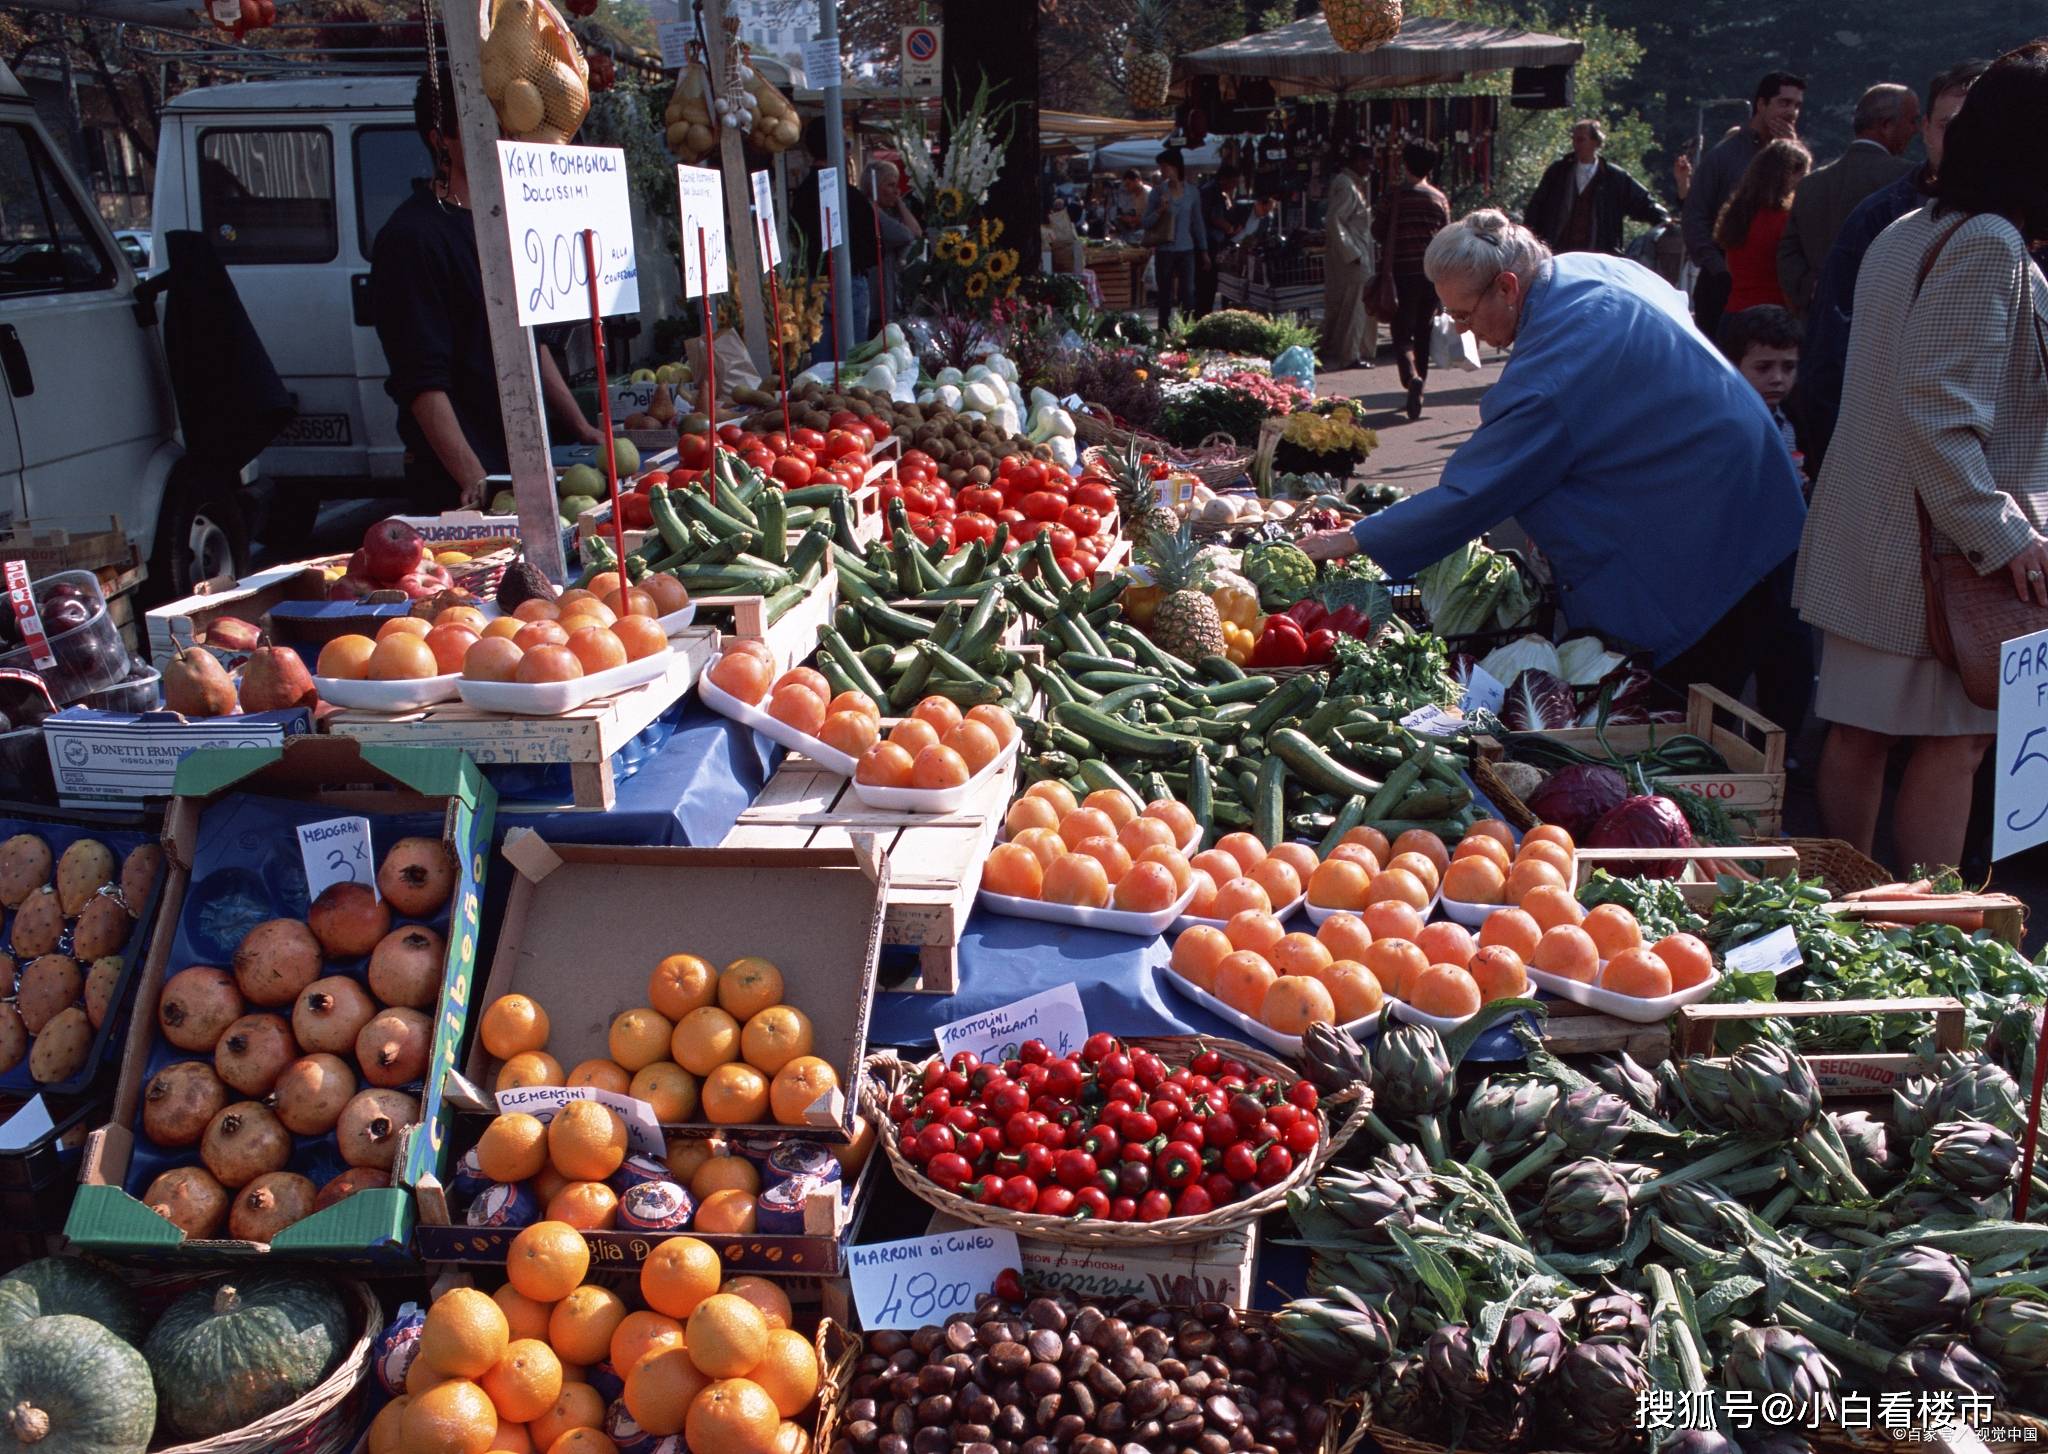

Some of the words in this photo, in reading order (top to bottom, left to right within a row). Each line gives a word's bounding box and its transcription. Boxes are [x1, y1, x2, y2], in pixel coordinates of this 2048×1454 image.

[505, 148, 543, 178] KAKI
[550, 151, 617, 176] ROMAGNOLI
[523, 183, 589, 202] DOLCISSIMI
[92, 744, 146, 757] BONETTI
[120, 757, 153, 765] VIGNOLA
[1819, 1059, 1896, 1085] SECONDO
[853, 1245, 923, 1266] MARRONI
[947, 1235, 995, 1252] CUNEO
[1071, 1258, 1125, 1272] PRODUCE
[874, 1272, 971, 1324] 4800
